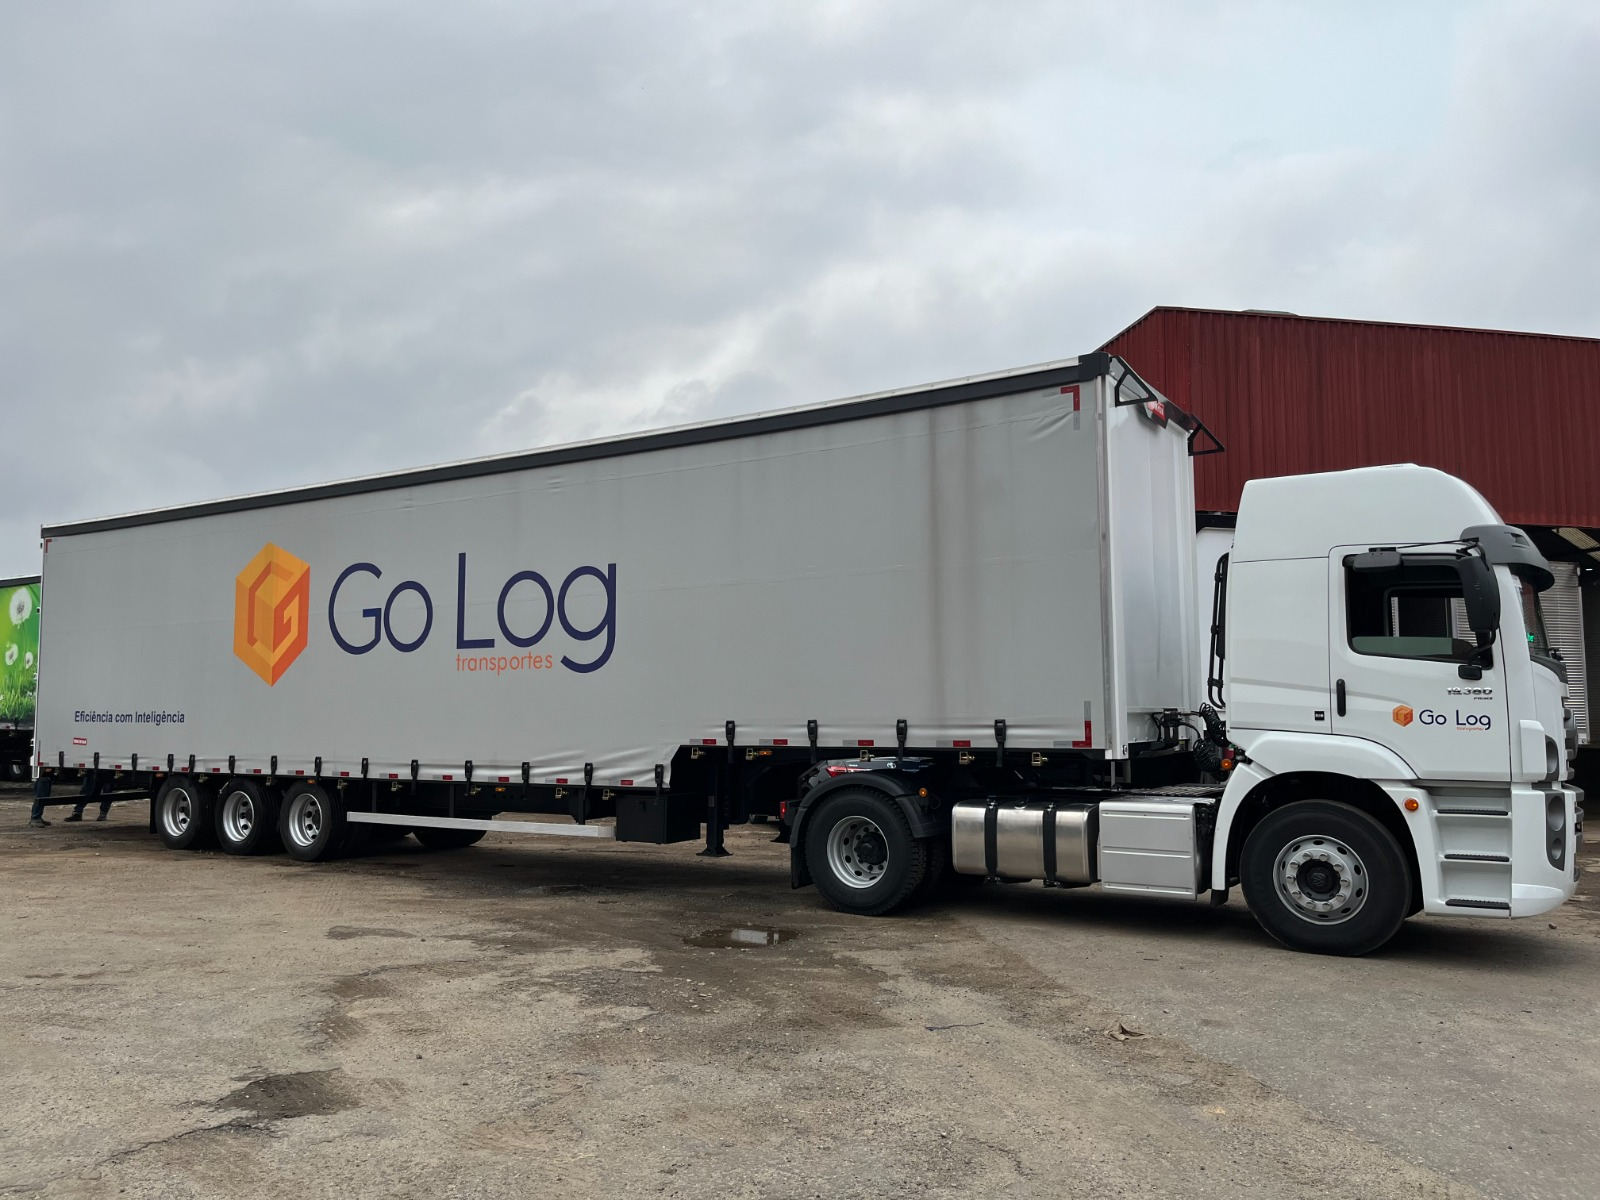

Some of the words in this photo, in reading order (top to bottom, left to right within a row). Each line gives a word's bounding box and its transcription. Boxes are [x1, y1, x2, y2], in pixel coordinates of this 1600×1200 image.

[328, 562, 433, 655] Go
[456, 552, 617, 673] Log
[456, 651, 553, 676] transportes
[74, 710, 113, 723] Eficiência
[115, 713, 133, 723] com
[135, 711, 185, 726] Inteligência
[1419, 709, 1447, 726] Go
[1456, 709, 1491, 731] Log
